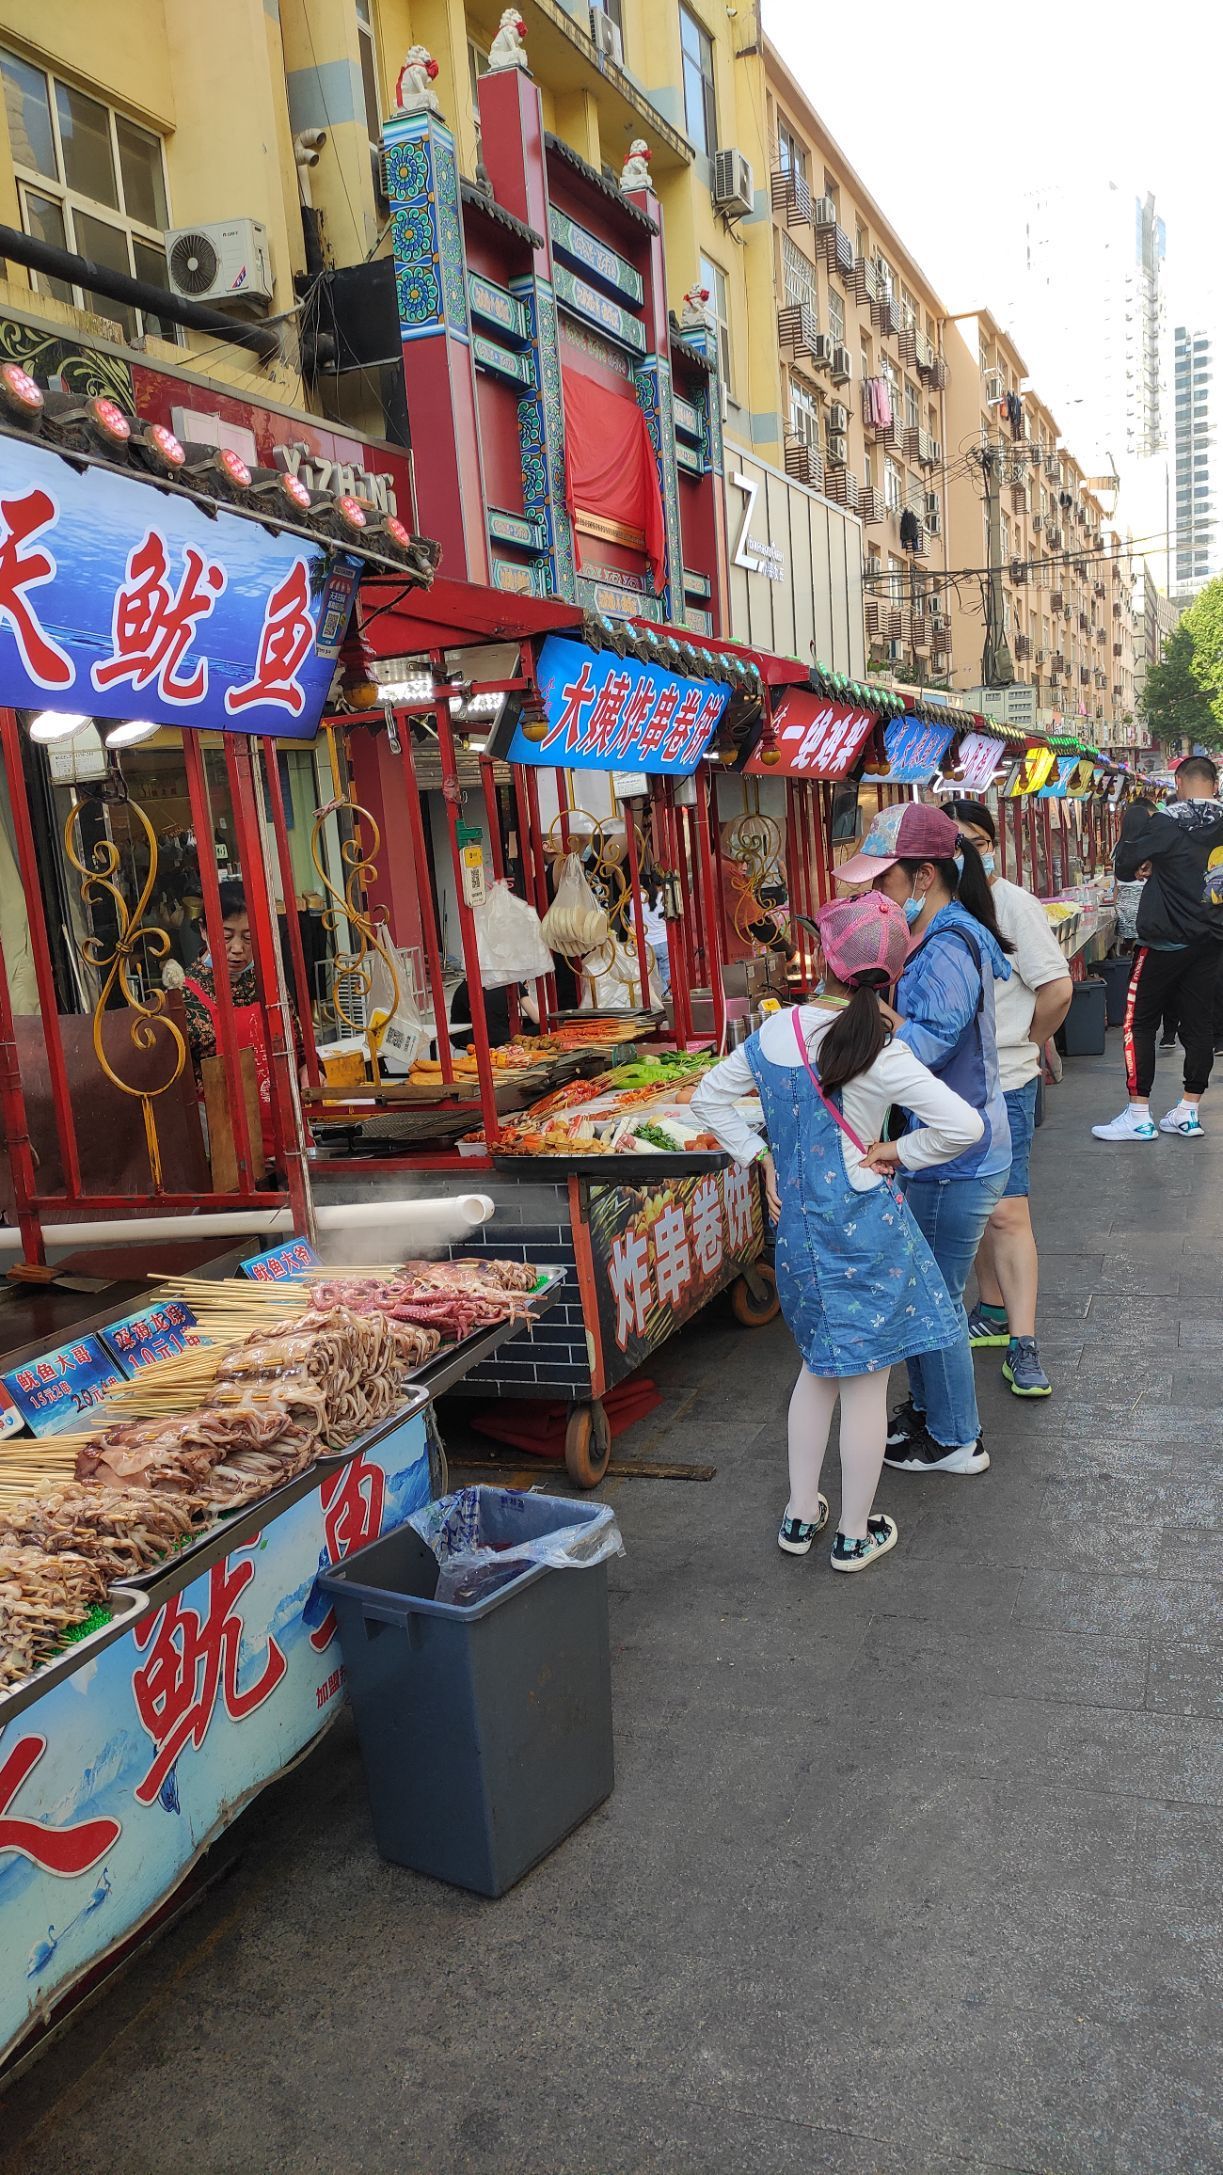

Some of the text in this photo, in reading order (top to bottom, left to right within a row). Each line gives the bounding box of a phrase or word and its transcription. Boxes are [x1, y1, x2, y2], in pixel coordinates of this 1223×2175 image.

[608, 1162, 754, 1352] 炸串卷饼
[16, 1344, 93, 1392] 鱿鱼大哥
[30, 1381, 73, 1409] 15元2串
